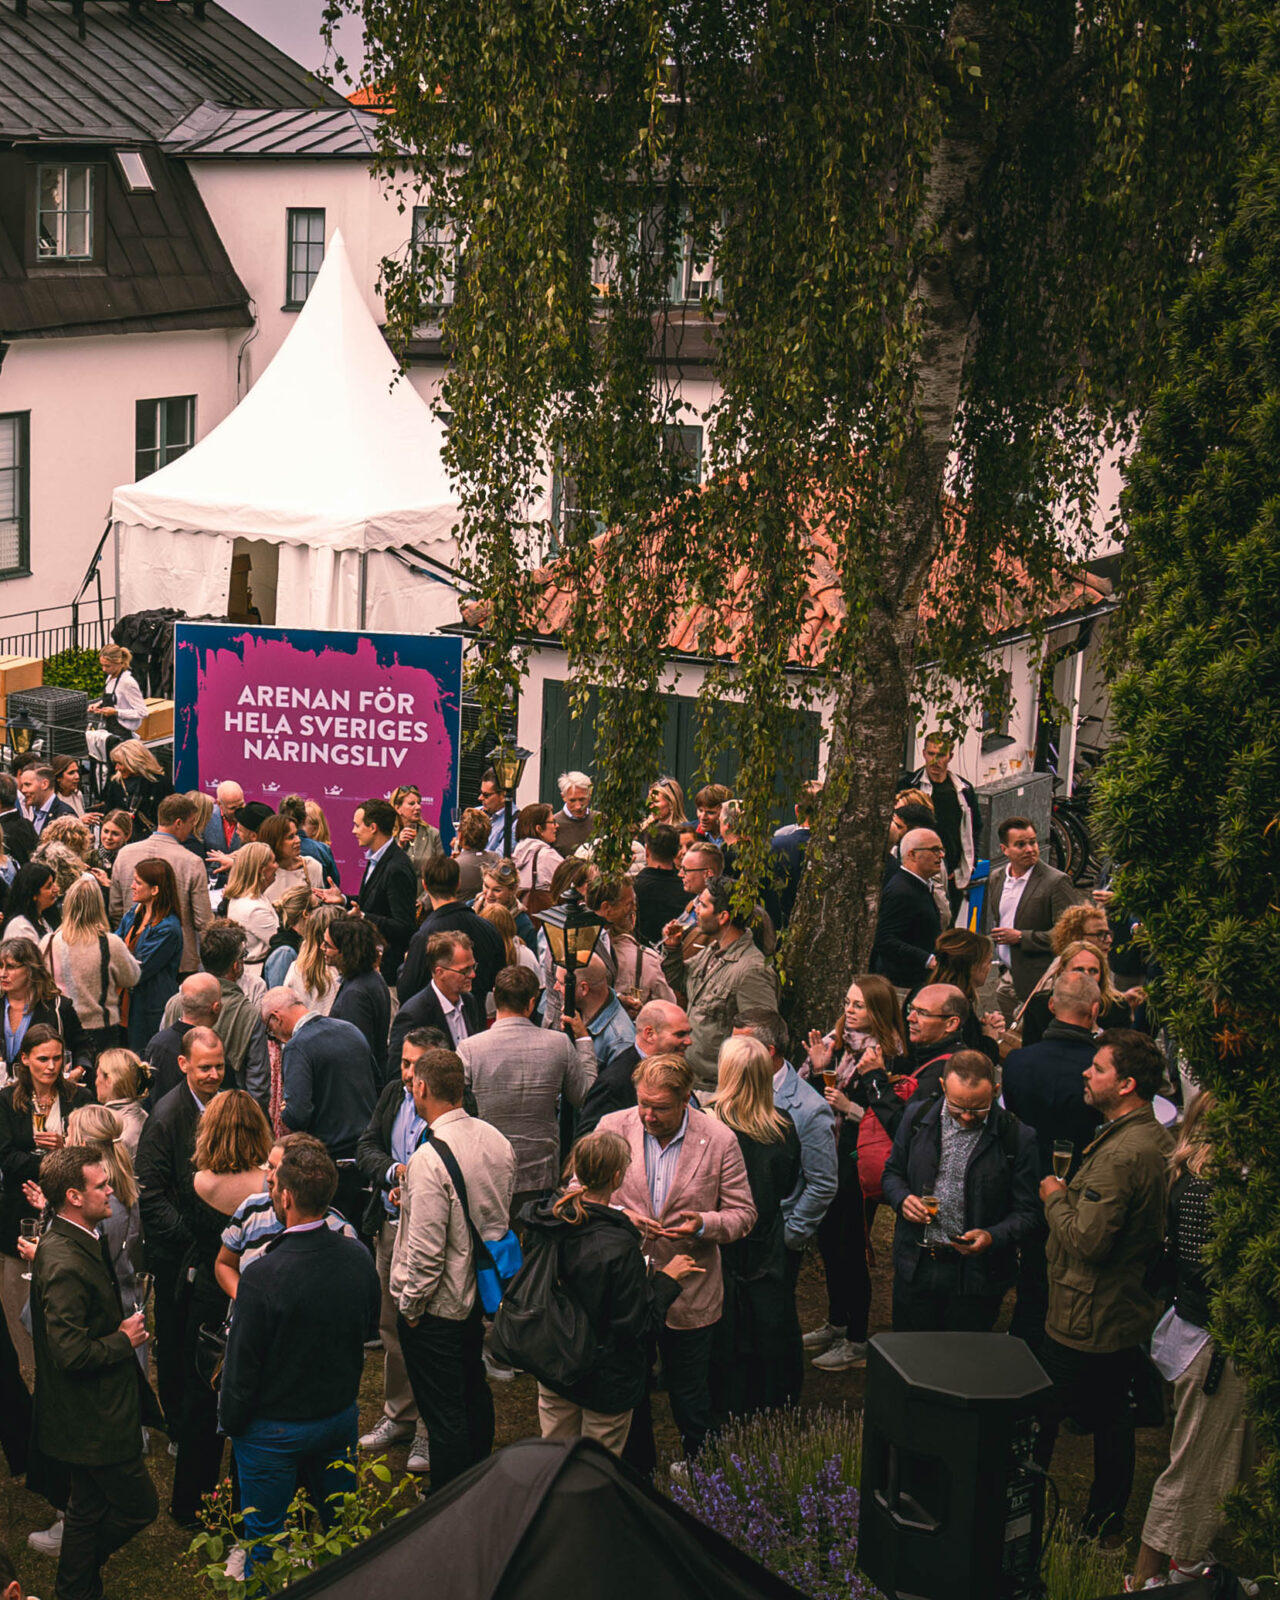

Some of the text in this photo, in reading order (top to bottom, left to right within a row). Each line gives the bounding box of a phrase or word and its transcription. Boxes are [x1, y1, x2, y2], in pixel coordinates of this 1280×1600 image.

[237, 685, 415, 715] ARENAN FÖR
[224, 711, 429, 743] HELA SVERIGES
[244, 734, 409, 769] NÄRINGSLIV
